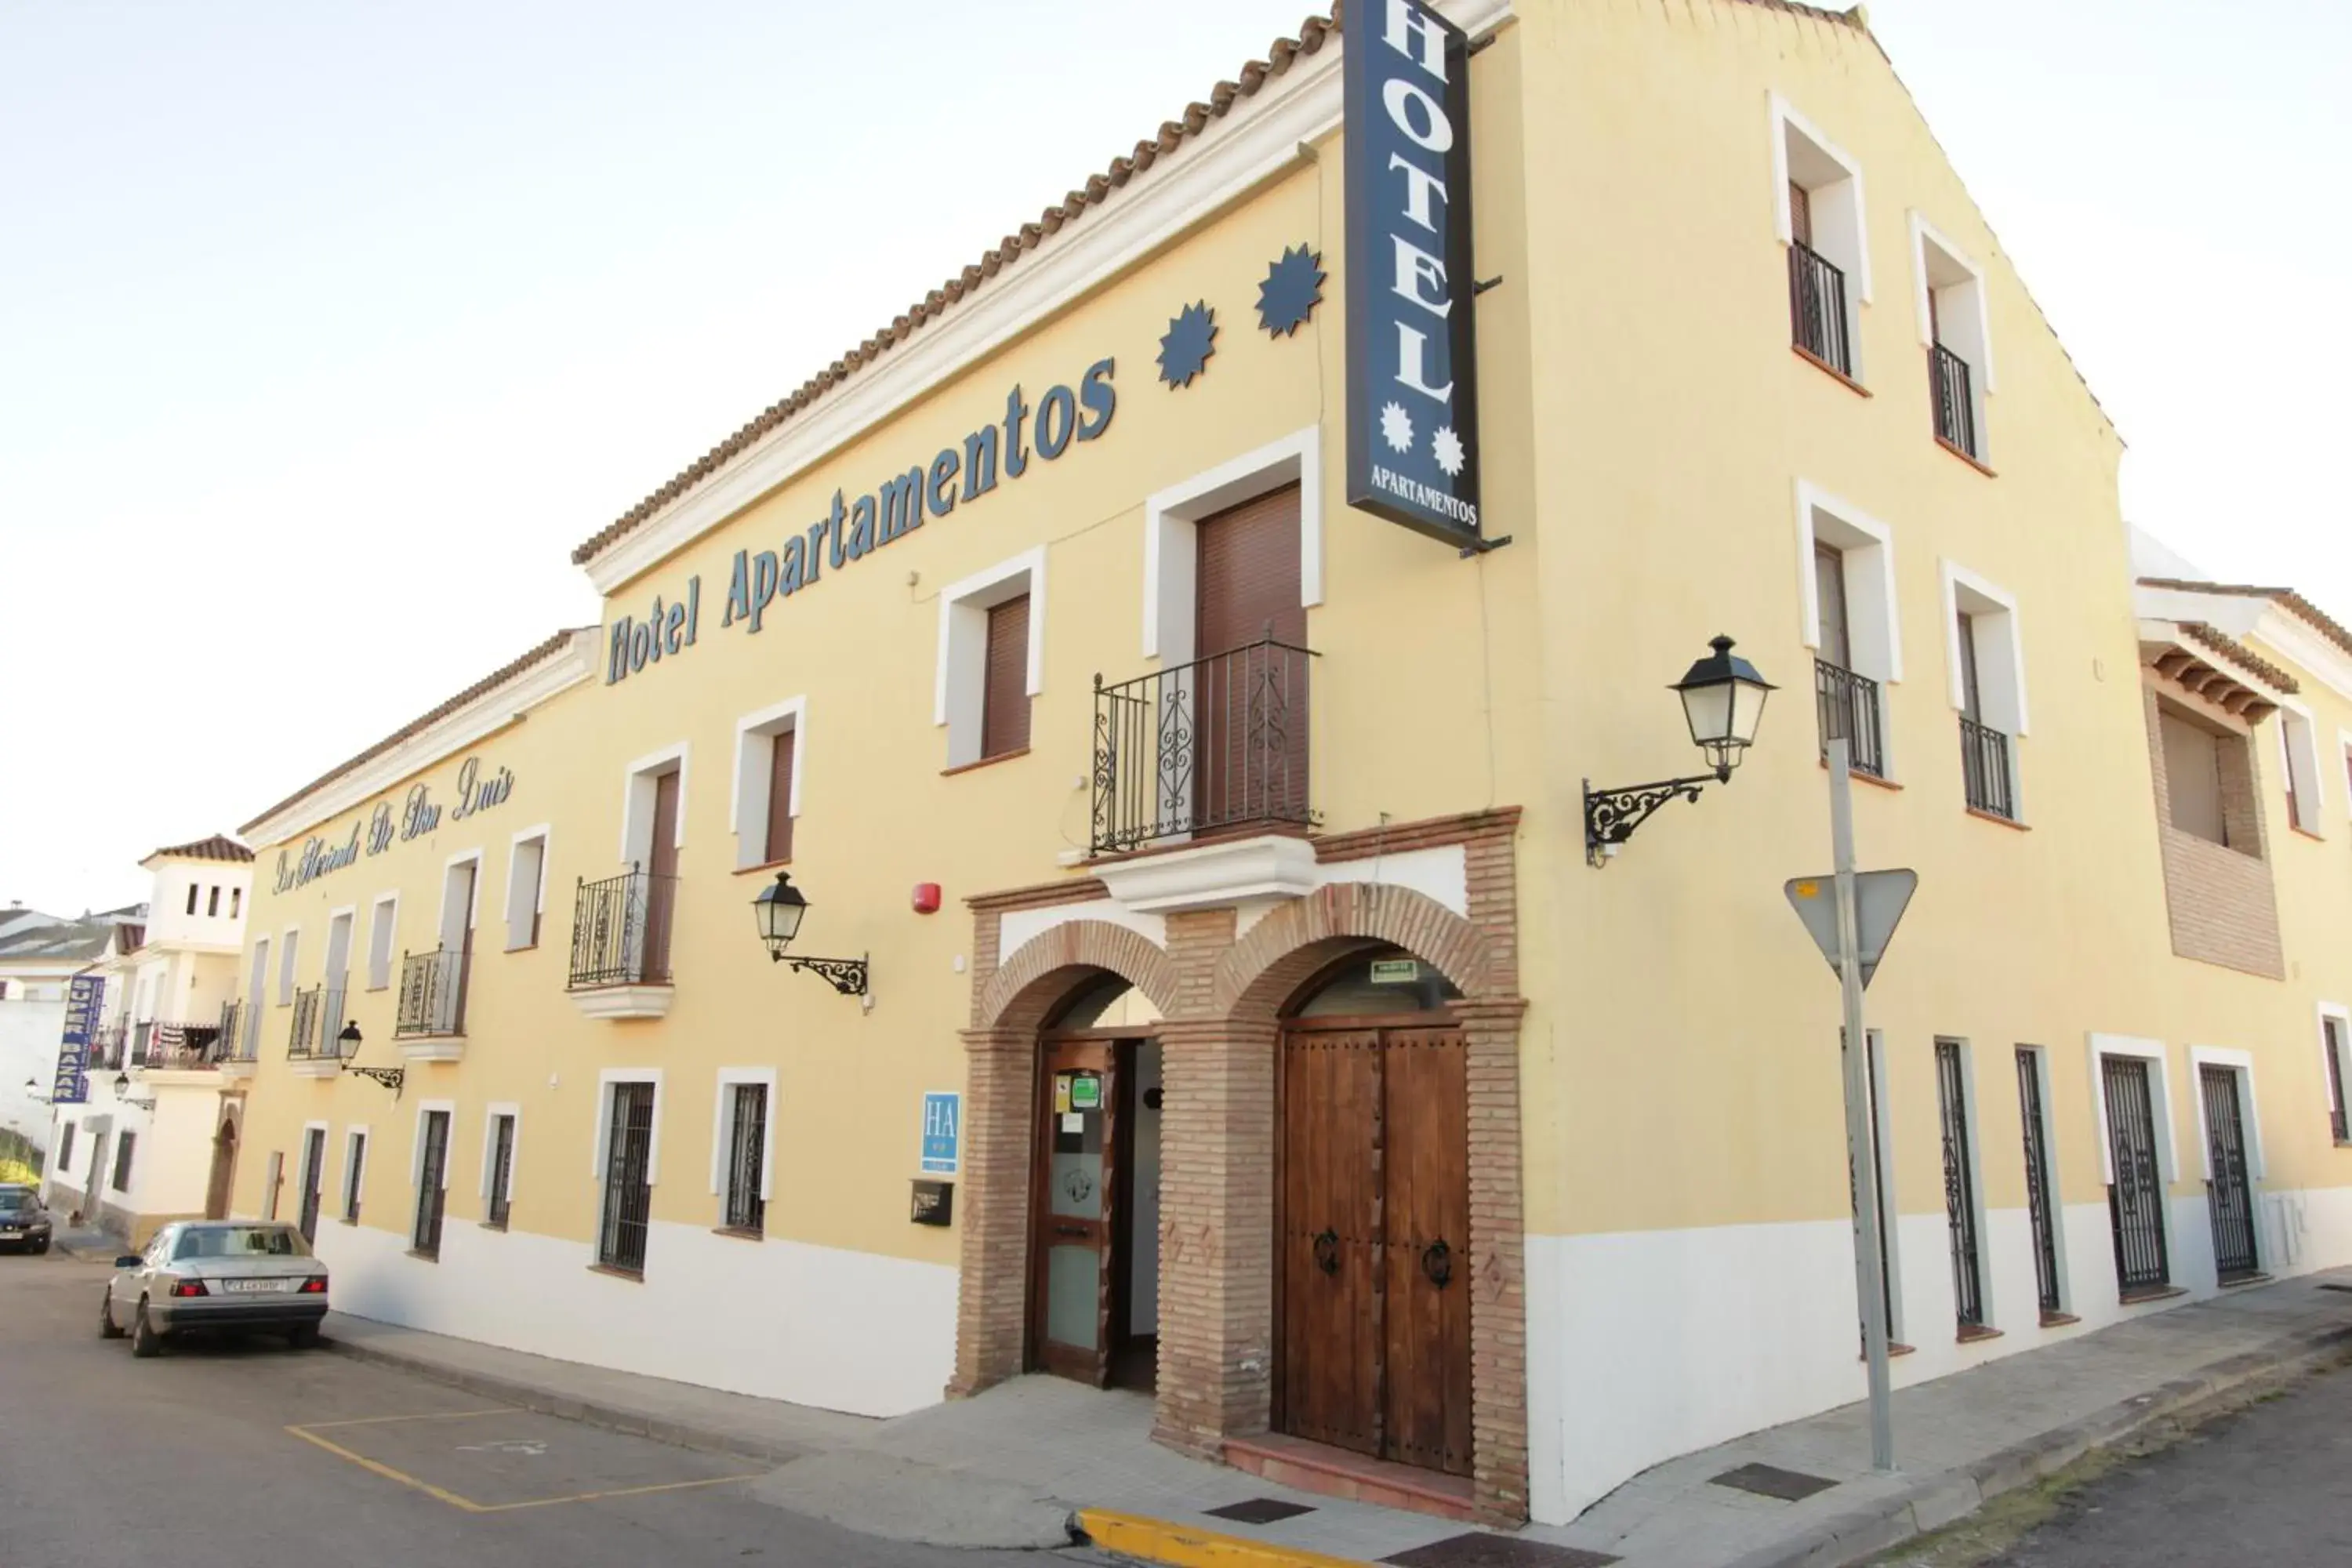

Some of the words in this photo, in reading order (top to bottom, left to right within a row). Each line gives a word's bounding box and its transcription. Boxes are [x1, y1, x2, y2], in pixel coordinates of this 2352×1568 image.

[1381, 0, 1454, 404] HOTEL
[605, 575, 700, 686] Hotel
[721, 357, 1117, 633] Apartamentos
[1371, 464, 1477, 527] APARTAMENTOS
[452, 757, 515, 821] Luis
[54, 1042, 82, 1098] BAZAR
[926, 1101, 956, 1138] HA
